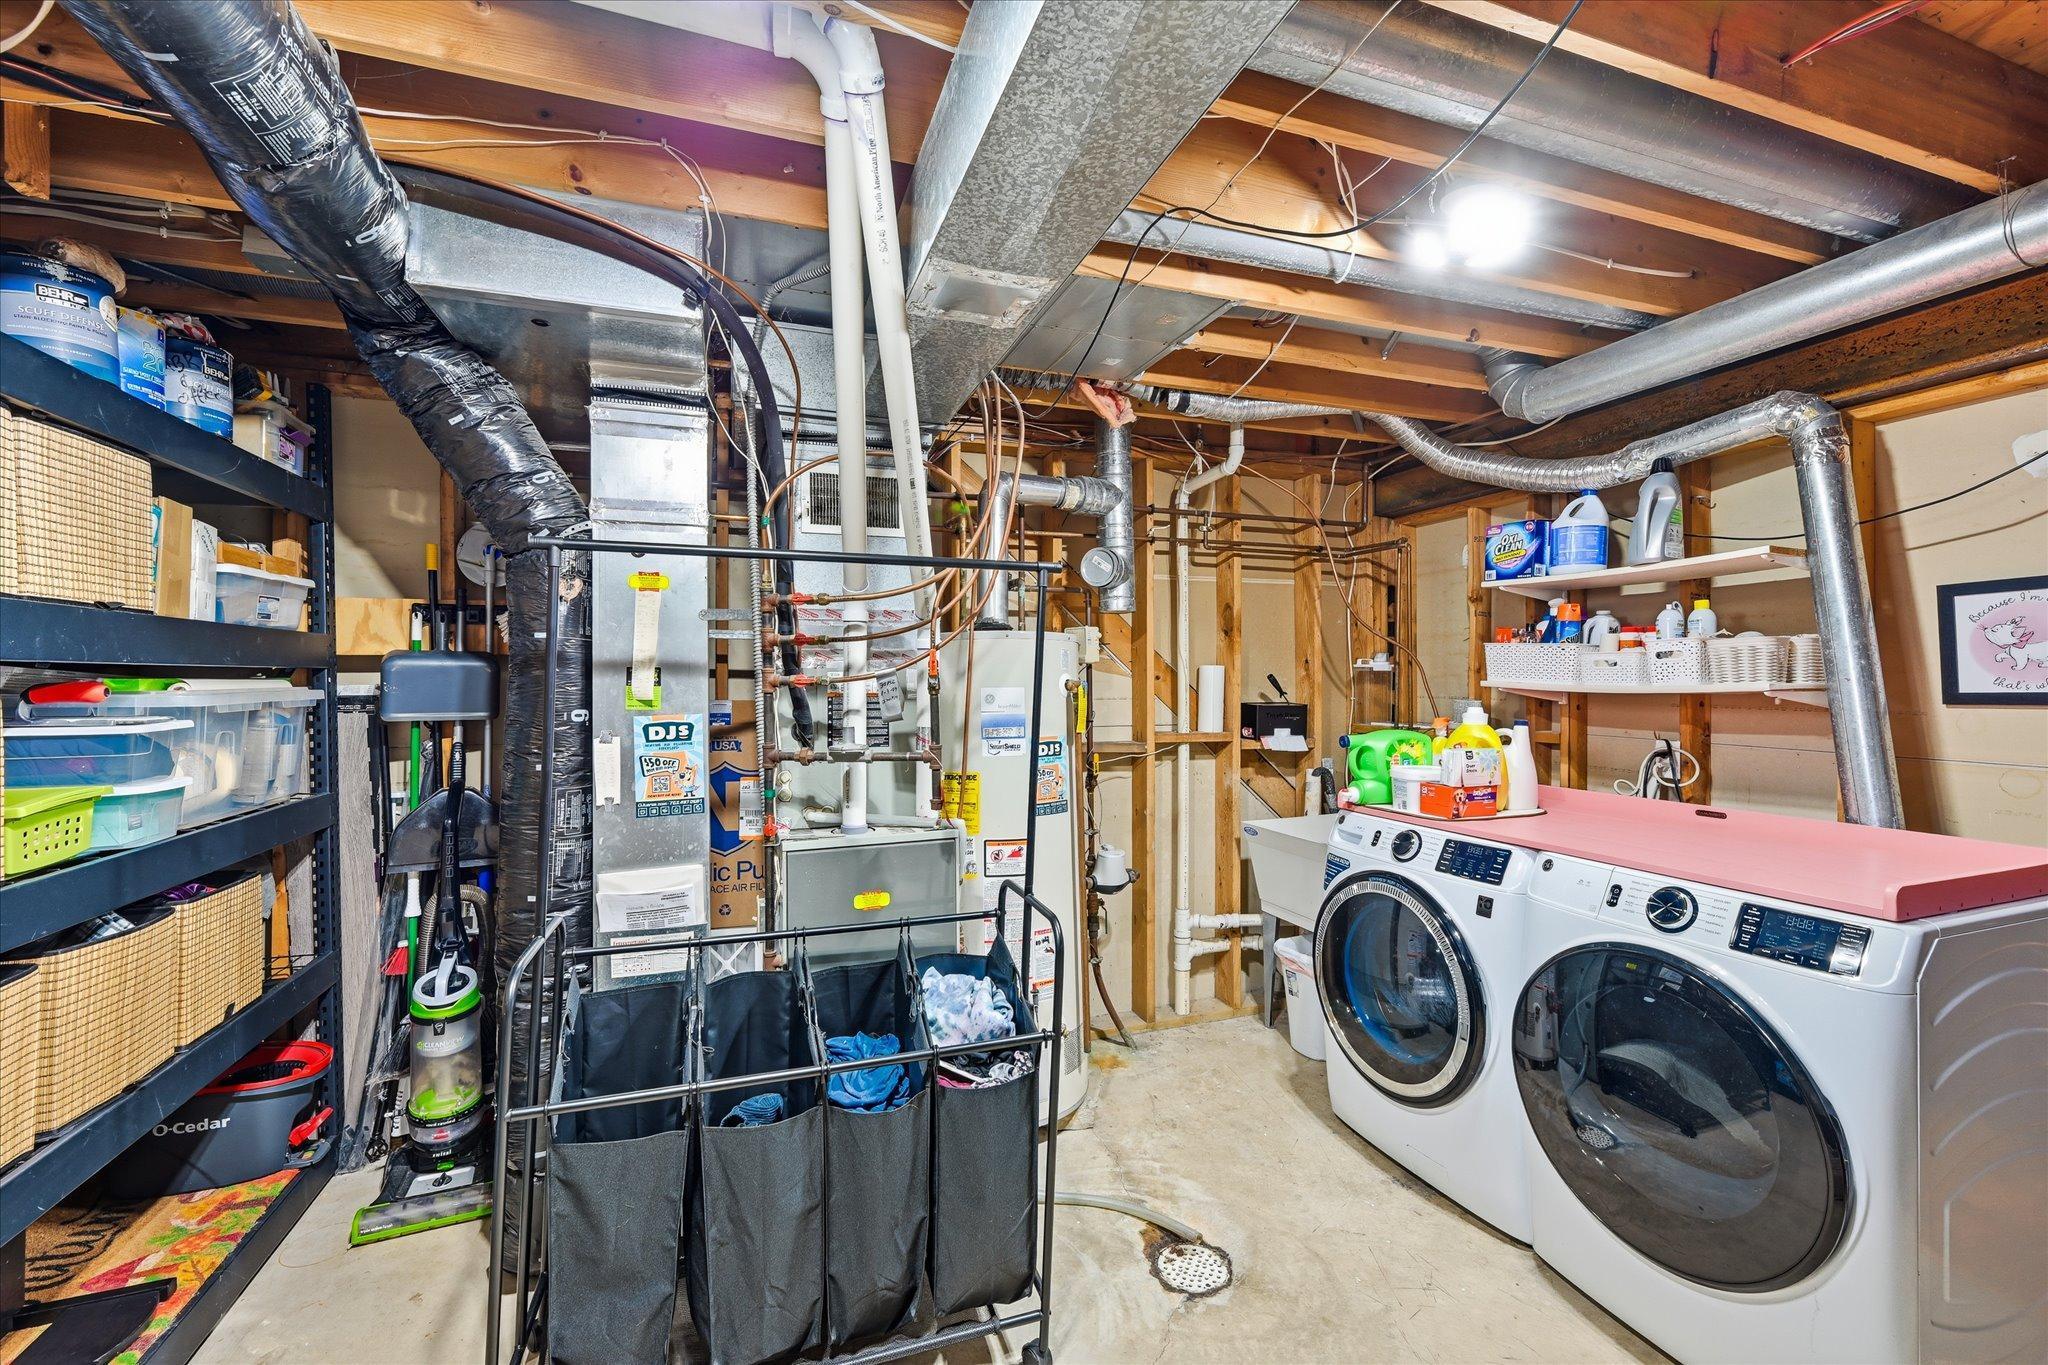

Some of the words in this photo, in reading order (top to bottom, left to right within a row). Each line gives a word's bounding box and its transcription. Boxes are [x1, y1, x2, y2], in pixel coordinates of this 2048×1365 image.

[868, 138, 877, 156] Pipe
[871, 156, 882, 190] American
[874, 193, 884, 214] North
[38, 285, 76, 302] BEHR
[17, 305, 57, 317] SCUFF
[61, 313, 105, 331] DEFENSE
[204, 366, 224, 379] BEHR
[1501, 532, 1518, 545] OXI
[1494, 540, 1523, 556] CLEAN
[1968, 596, 2016, 623] Because
[2020, 590, 2043, 601] I'm
[1993, 676, 2031, 691] that's
[648, 725, 690, 741] DJS
[714, 741, 738, 751] USA
[1038, 743, 1061, 756] DJS
[644, 758, 661, 767] $50
[731, 884, 748, 892] AIR
[152, 1116, 231, 1137] O-Cedar
